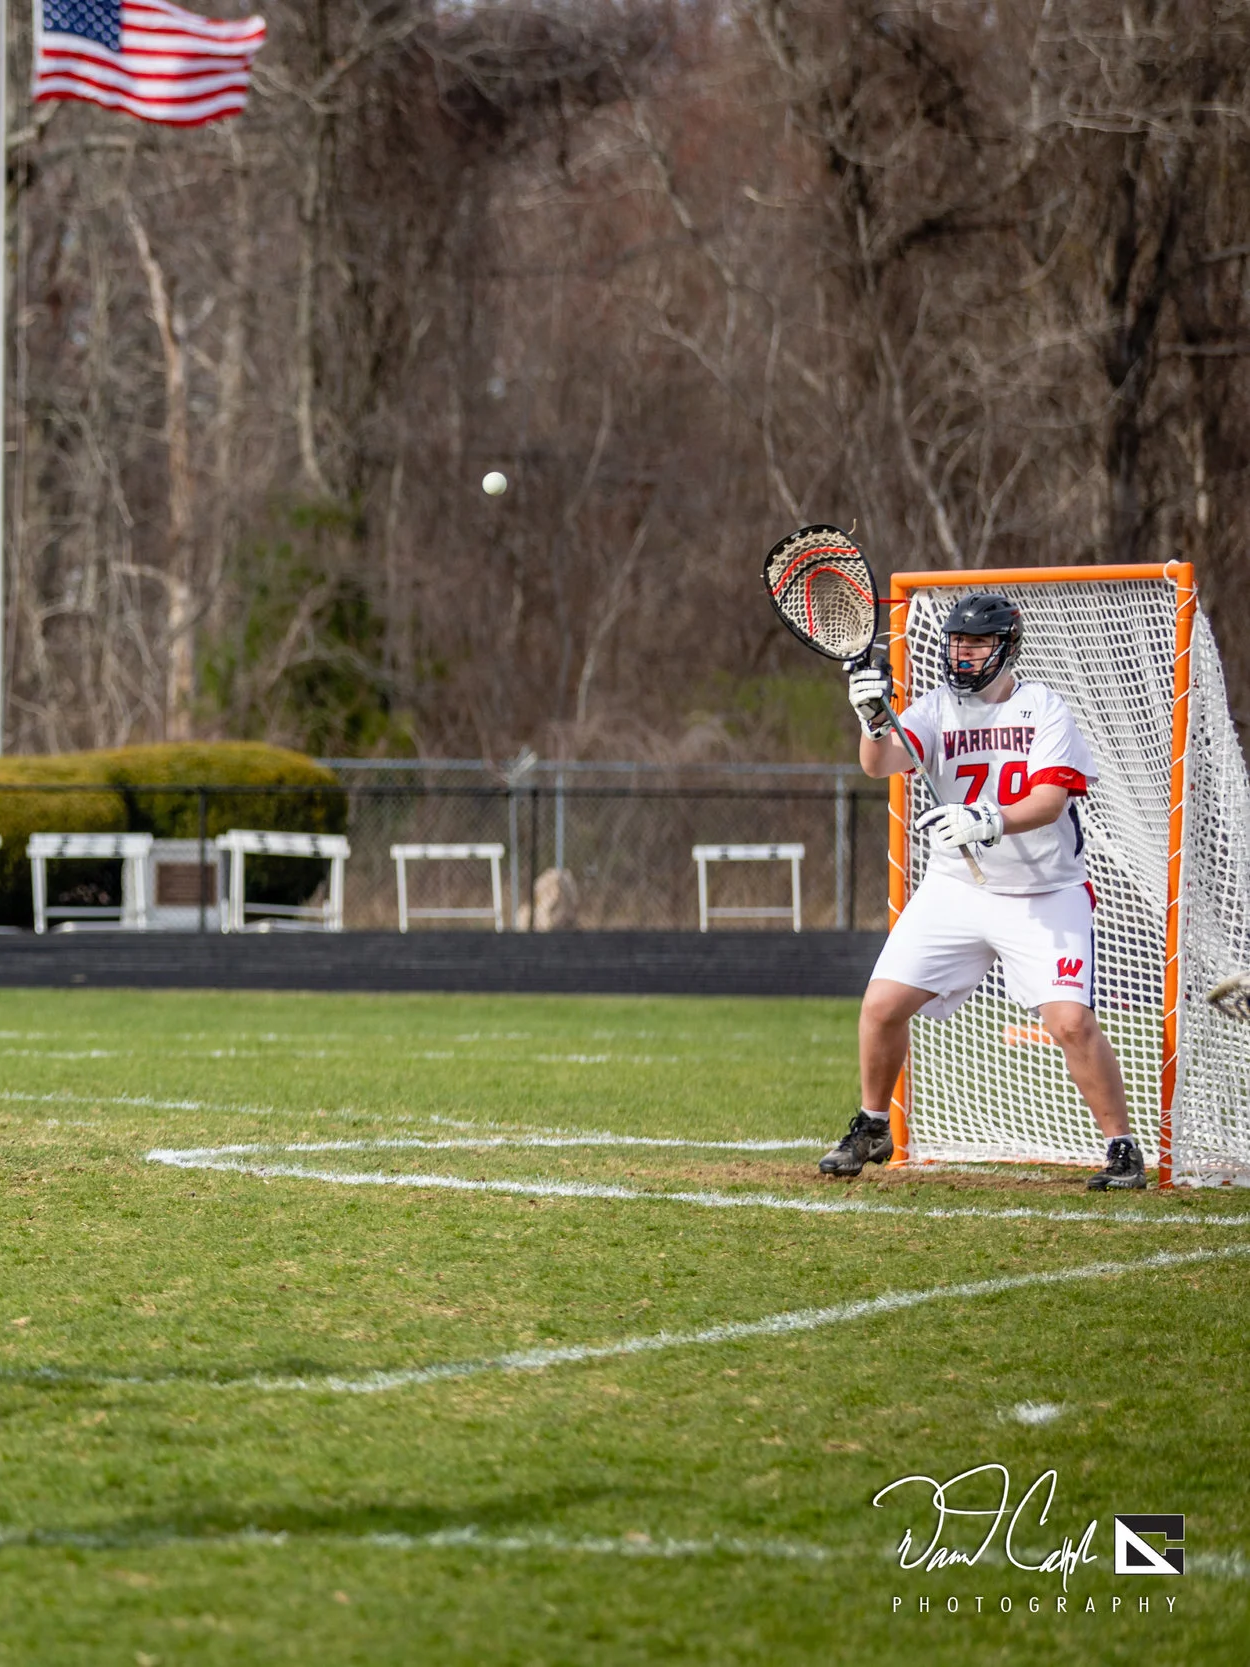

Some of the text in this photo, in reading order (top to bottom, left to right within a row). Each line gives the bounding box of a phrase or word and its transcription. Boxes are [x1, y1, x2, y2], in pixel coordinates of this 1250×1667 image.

[942, 726, 1036, 761] WARRIORS
[955, 761, 1031, 806] 70
[1057, 957, 1083, 978] W
